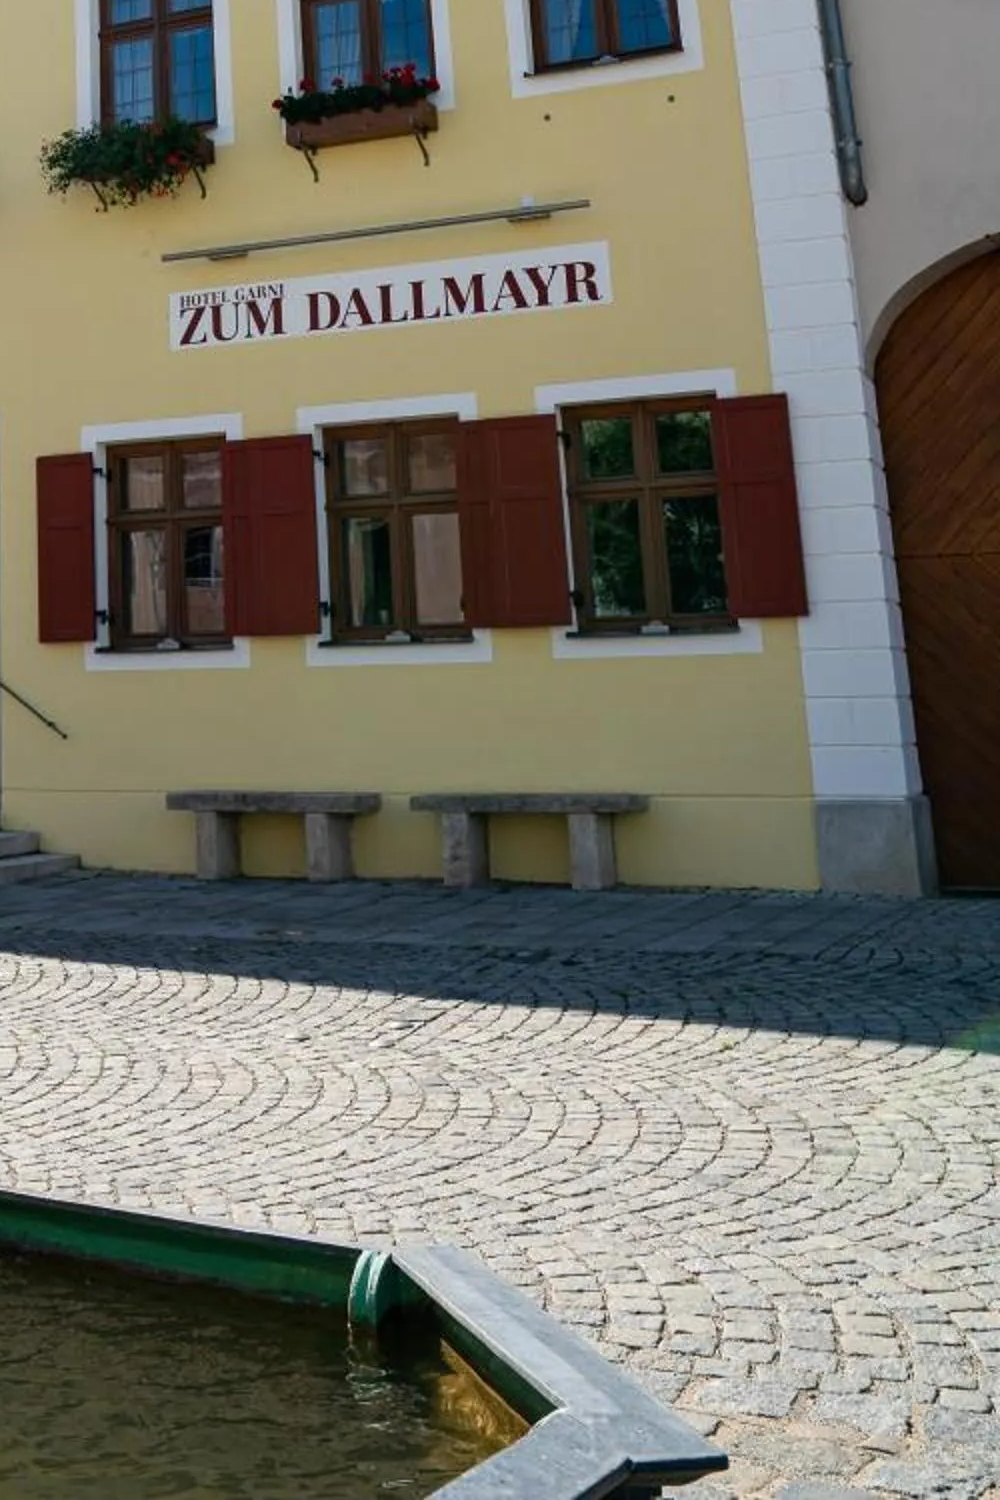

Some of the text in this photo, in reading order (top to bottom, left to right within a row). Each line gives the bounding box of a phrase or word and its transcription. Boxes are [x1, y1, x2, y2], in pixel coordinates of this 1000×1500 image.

[180, 283, 283, 308] HOTEL GARNI
[180, 261, 603, 345] ZUM DALLMAYR
